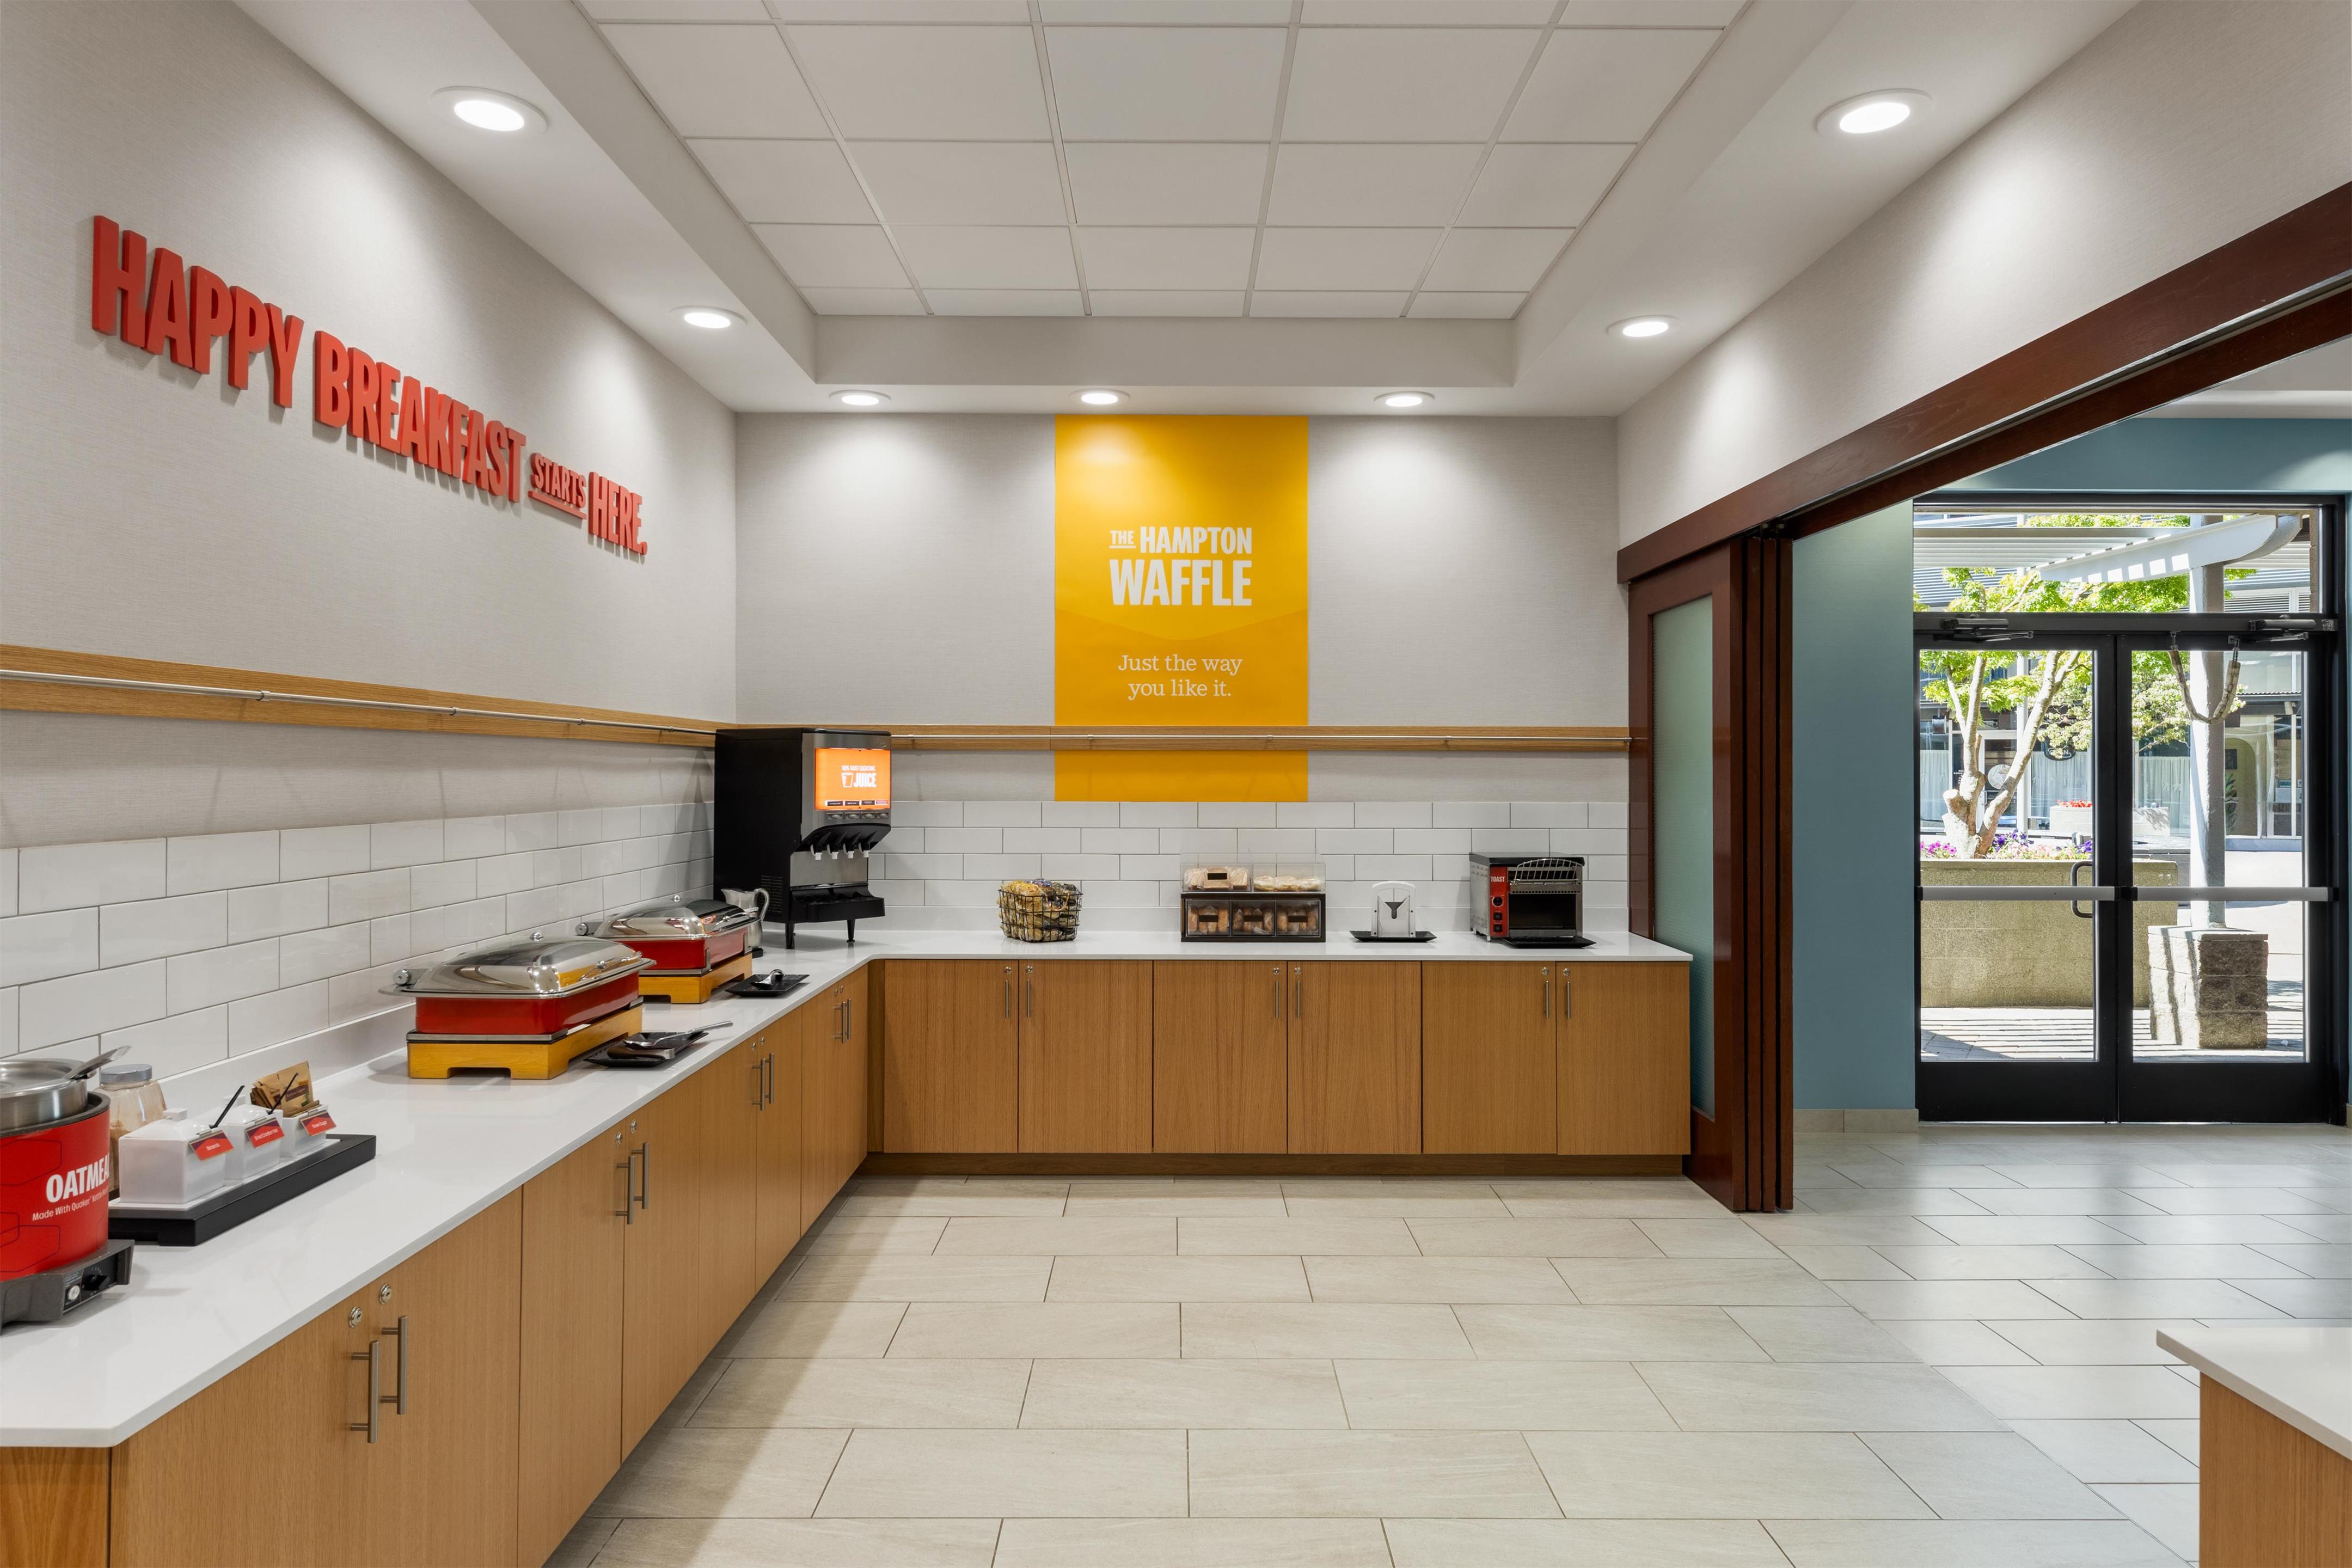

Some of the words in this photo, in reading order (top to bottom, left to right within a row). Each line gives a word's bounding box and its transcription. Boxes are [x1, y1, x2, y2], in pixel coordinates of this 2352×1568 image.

[91, 215, 304, 408] HAPPY
[314, 330, 526, 503] BREAKFAST
[530, 452, 586, 508] STARTS
[588, 471, 647, 555] HERE.
[1110, 530, 1135, 545] THE
[1140, 526, 1252, 554] HAMPTON
[1109, 559, 1252, 606] WAFFLE
[1118, 654, 1159, 671] Just
[1165, 654, 1197, 671] the
[1202, 658, 1243, 676] way
[1128, 683, 1165, 700] you
[1171, 679, 1208, 696] like
[1213, 680, 1231, 697] it.
[853, 773, 877, 787] JUICE
[46, 1152, 109, 1203] OATMEA
[32, 1209, 54, 1221] Made
[55, 1204, 70, 1216] With
[71, 1198, 90, 1211] Quaker
